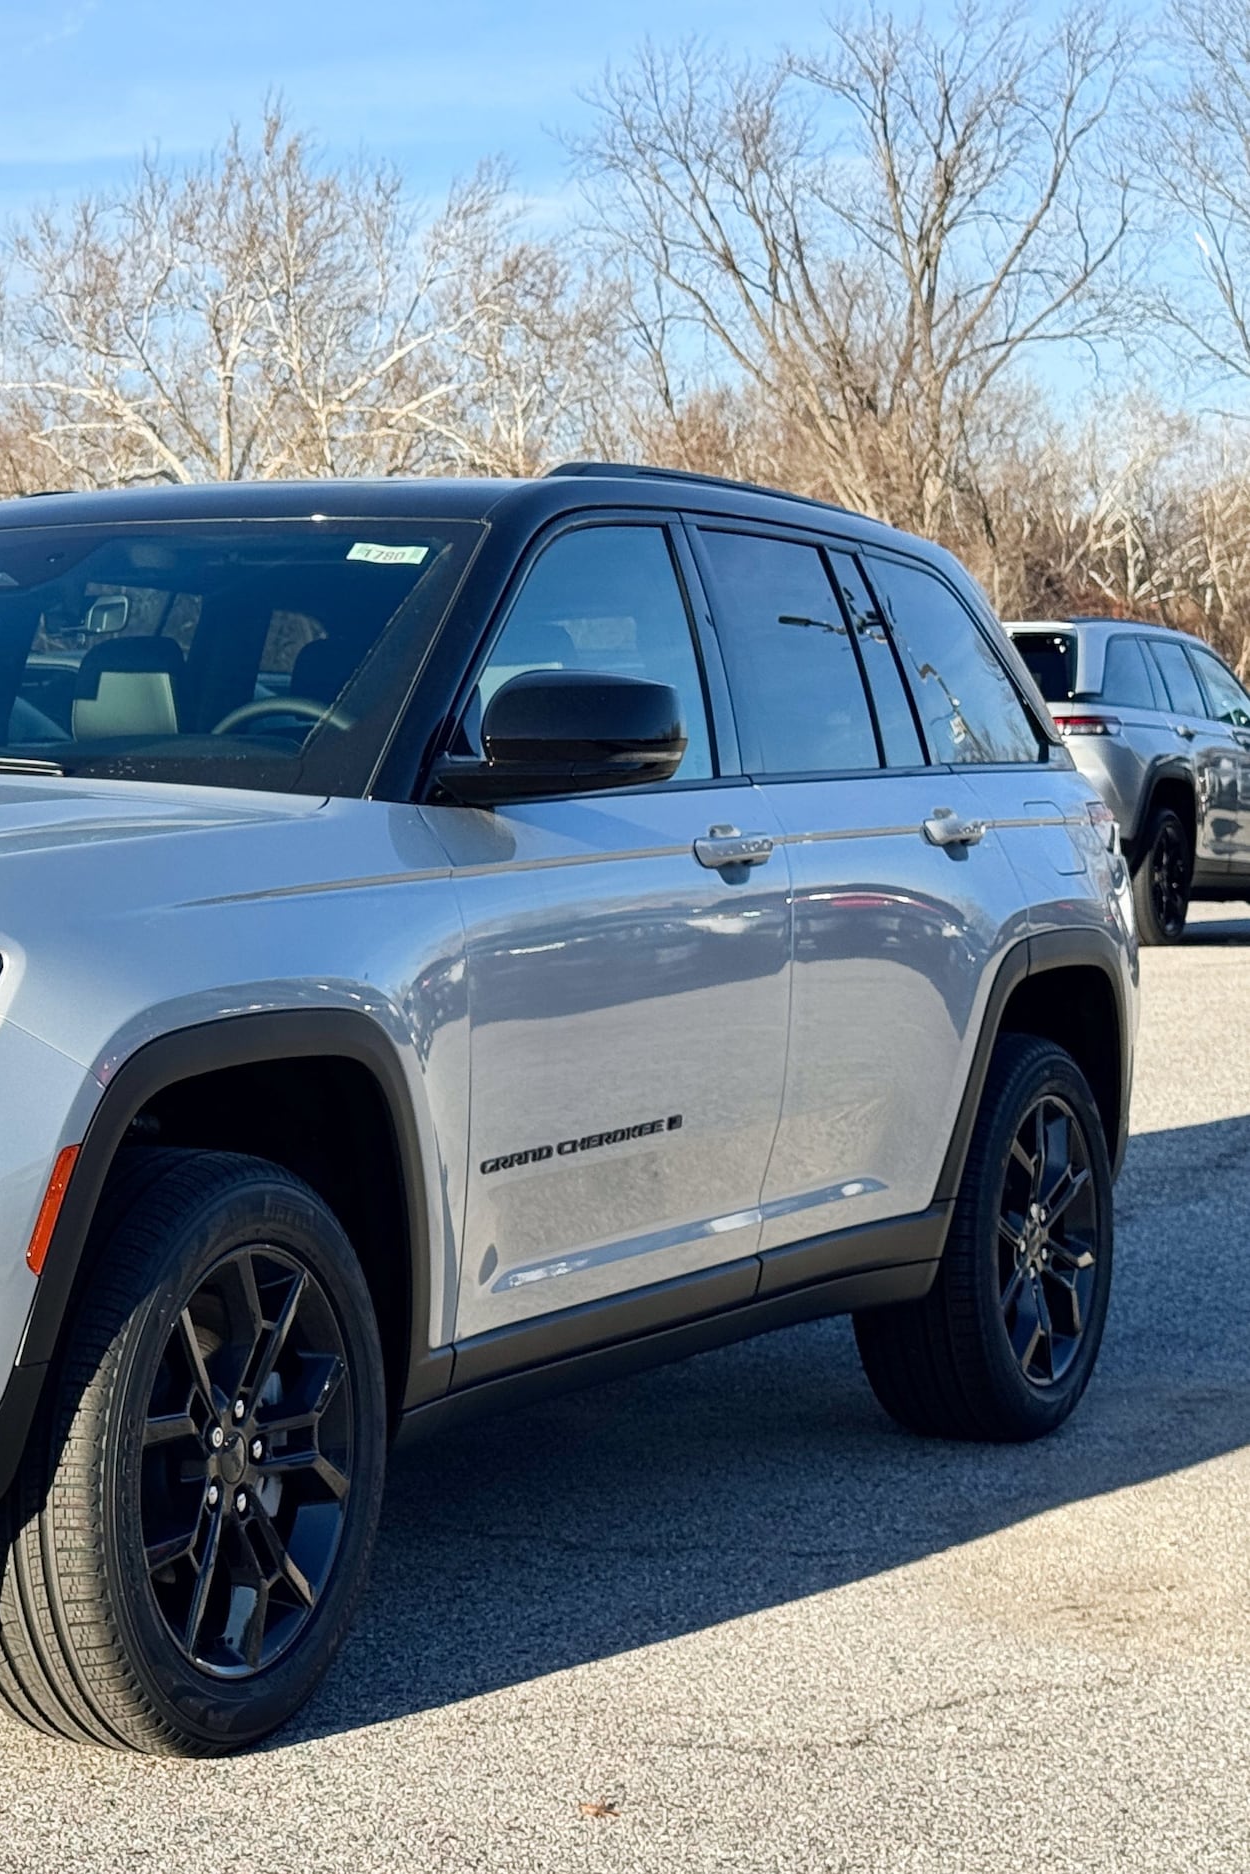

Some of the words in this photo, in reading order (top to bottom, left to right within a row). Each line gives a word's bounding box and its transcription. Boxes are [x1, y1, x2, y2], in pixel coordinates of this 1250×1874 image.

[364, 548, 406, 562] 1780
[480, 1145, 553, 1175] GRAND
[556, 1119, 665, 1156] CHEROKEE
